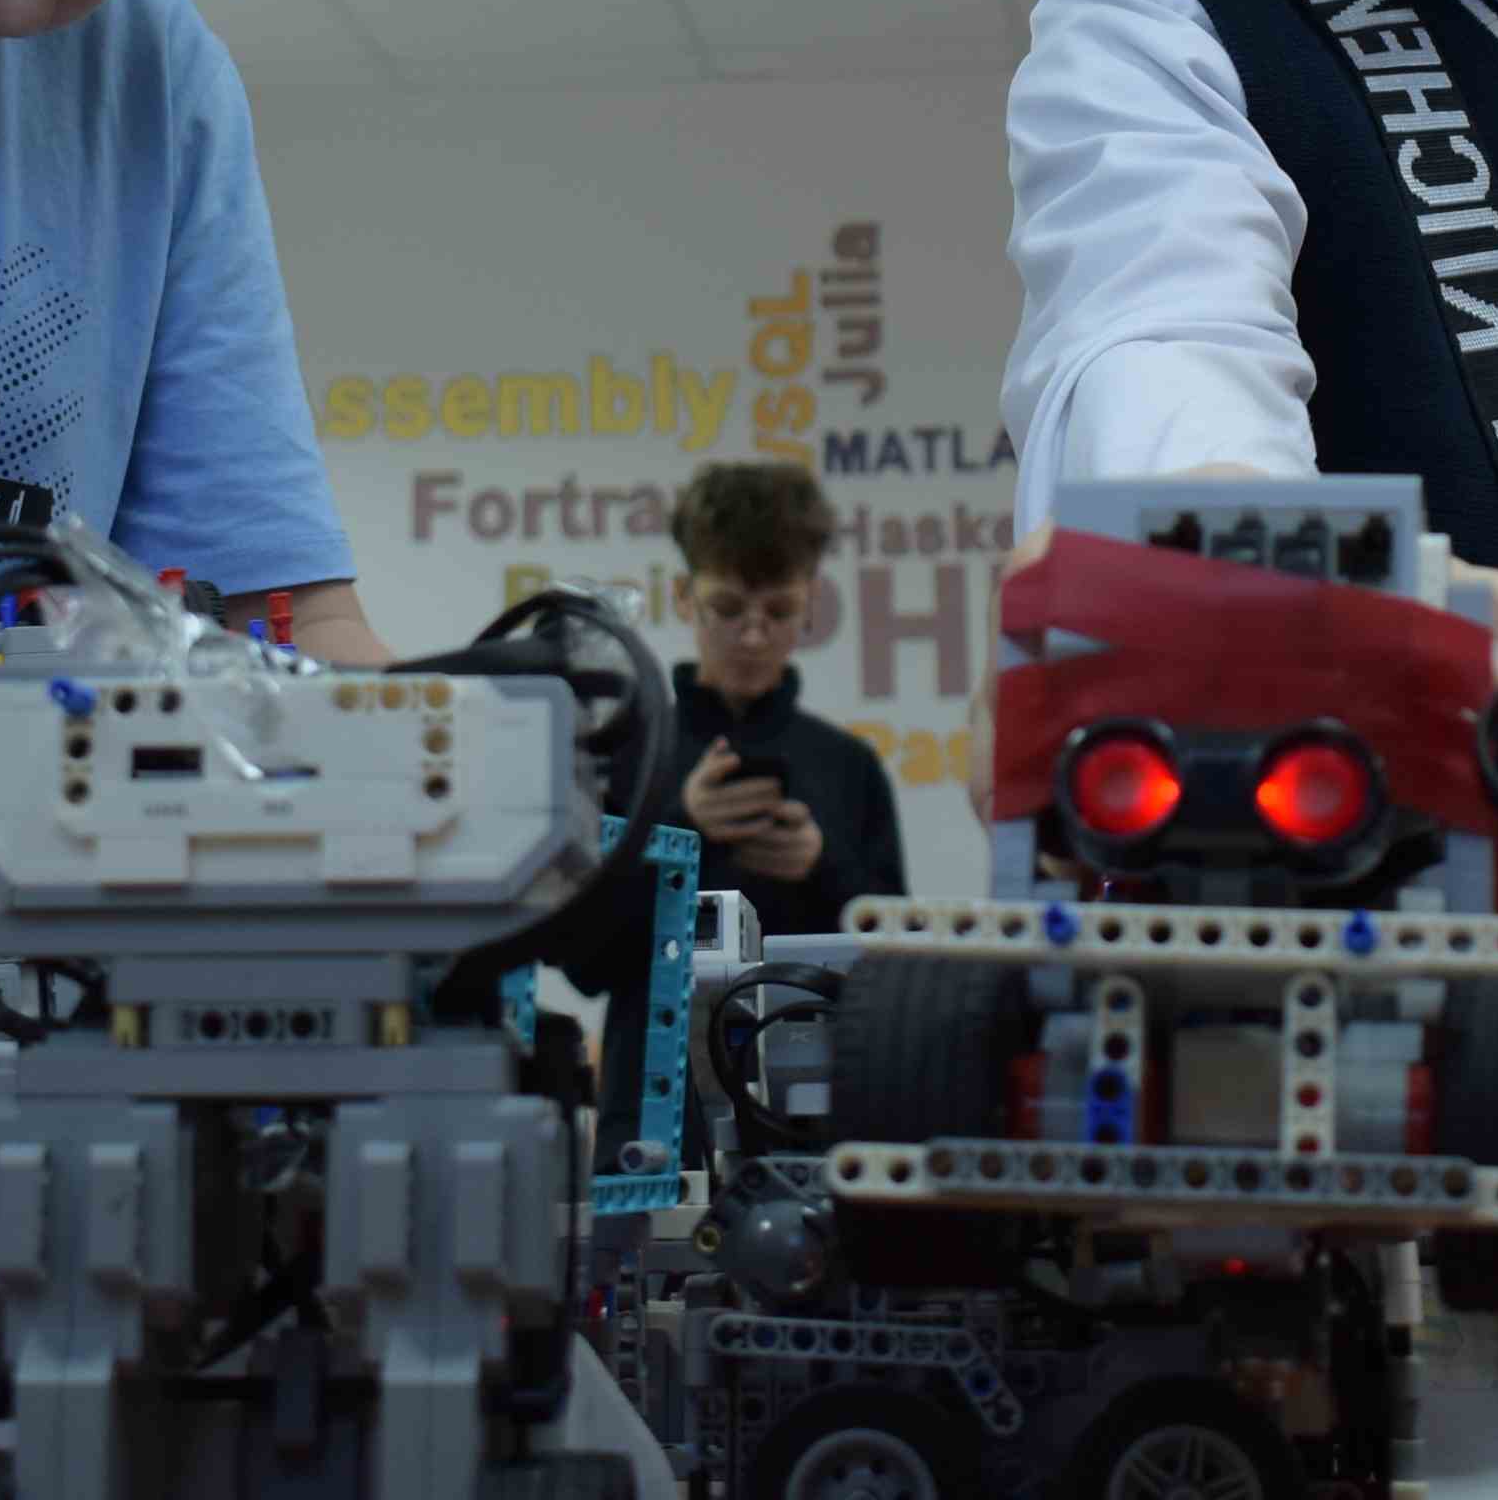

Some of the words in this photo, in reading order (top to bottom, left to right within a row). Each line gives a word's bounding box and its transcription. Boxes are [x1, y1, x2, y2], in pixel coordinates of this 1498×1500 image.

[819, 220, 887, 406] Julia
[319, 348, 740, 452] ssembly
[821, 426, 1018, 474] MATLA
[410, 467, 678, 546] Fortra
[829, 500, 1015, 554] Haske
